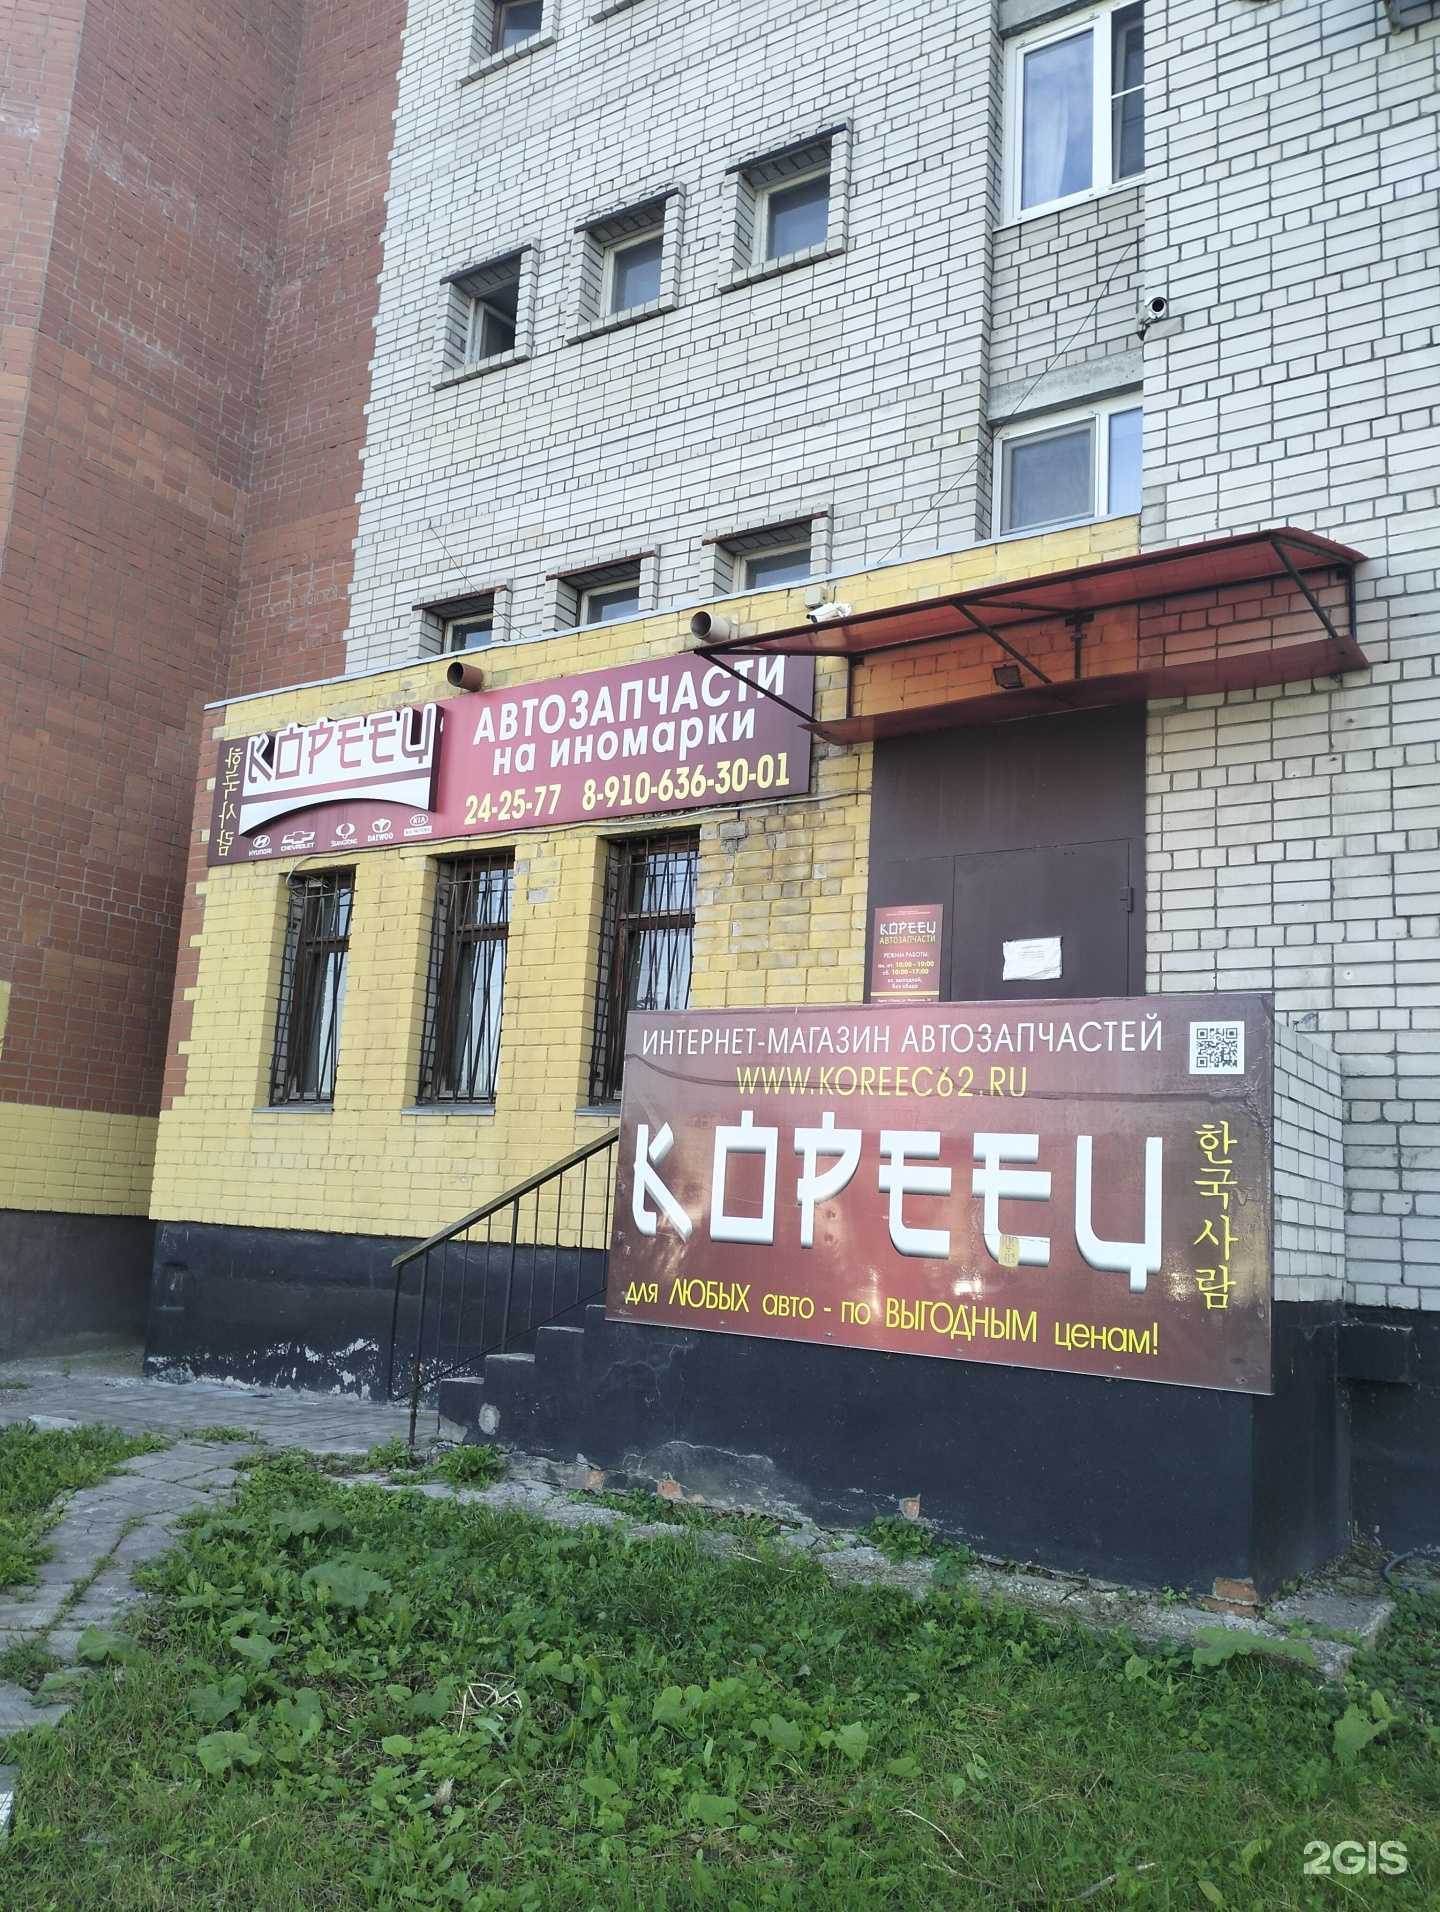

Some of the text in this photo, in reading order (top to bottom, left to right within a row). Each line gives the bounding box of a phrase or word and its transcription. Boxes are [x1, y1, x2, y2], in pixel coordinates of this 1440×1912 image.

[473, 655, 785, 745] АВТОЗАПЧАСТИ
[249, 703, 438, 784] КОРЕЕЦ
[492, 708, 755, 776] на иномарки
[464, 752, 790, 825] 24-25-77 8-910-636-30-01
[281, 842, 315, 851] CHEVROLET
[367, 832, 394, 842] DAEWOO
[880, 921, 936, 935] КОРЕЕЦ
[880, 935, 936, 945] АВТОЗАПЧАСТИ
[642, 1013, 1163, 1056] ИНТЕРНЕТ-МАГАЗИН АВТОЗАПЧАСТЕЙ
[736, 1066, 1027, 1097] WWW.KOREEC62.RU
[632, 1110, 1163, 1294] КОРЕЕЦ
[1193, 1120, 1239, 1310] 한국사람
[625, 1281, 658, 1305] для
[669, 1278, 750, 1313] ЛЮБЫХ
[762, 1293, 815, 1319] авто
[841, 1301, 872, 1325] по
[885, 1297, 1037, 1343] ВЫГОДНЫМ
[1055, 1322, 1159, 1355] ценам!
